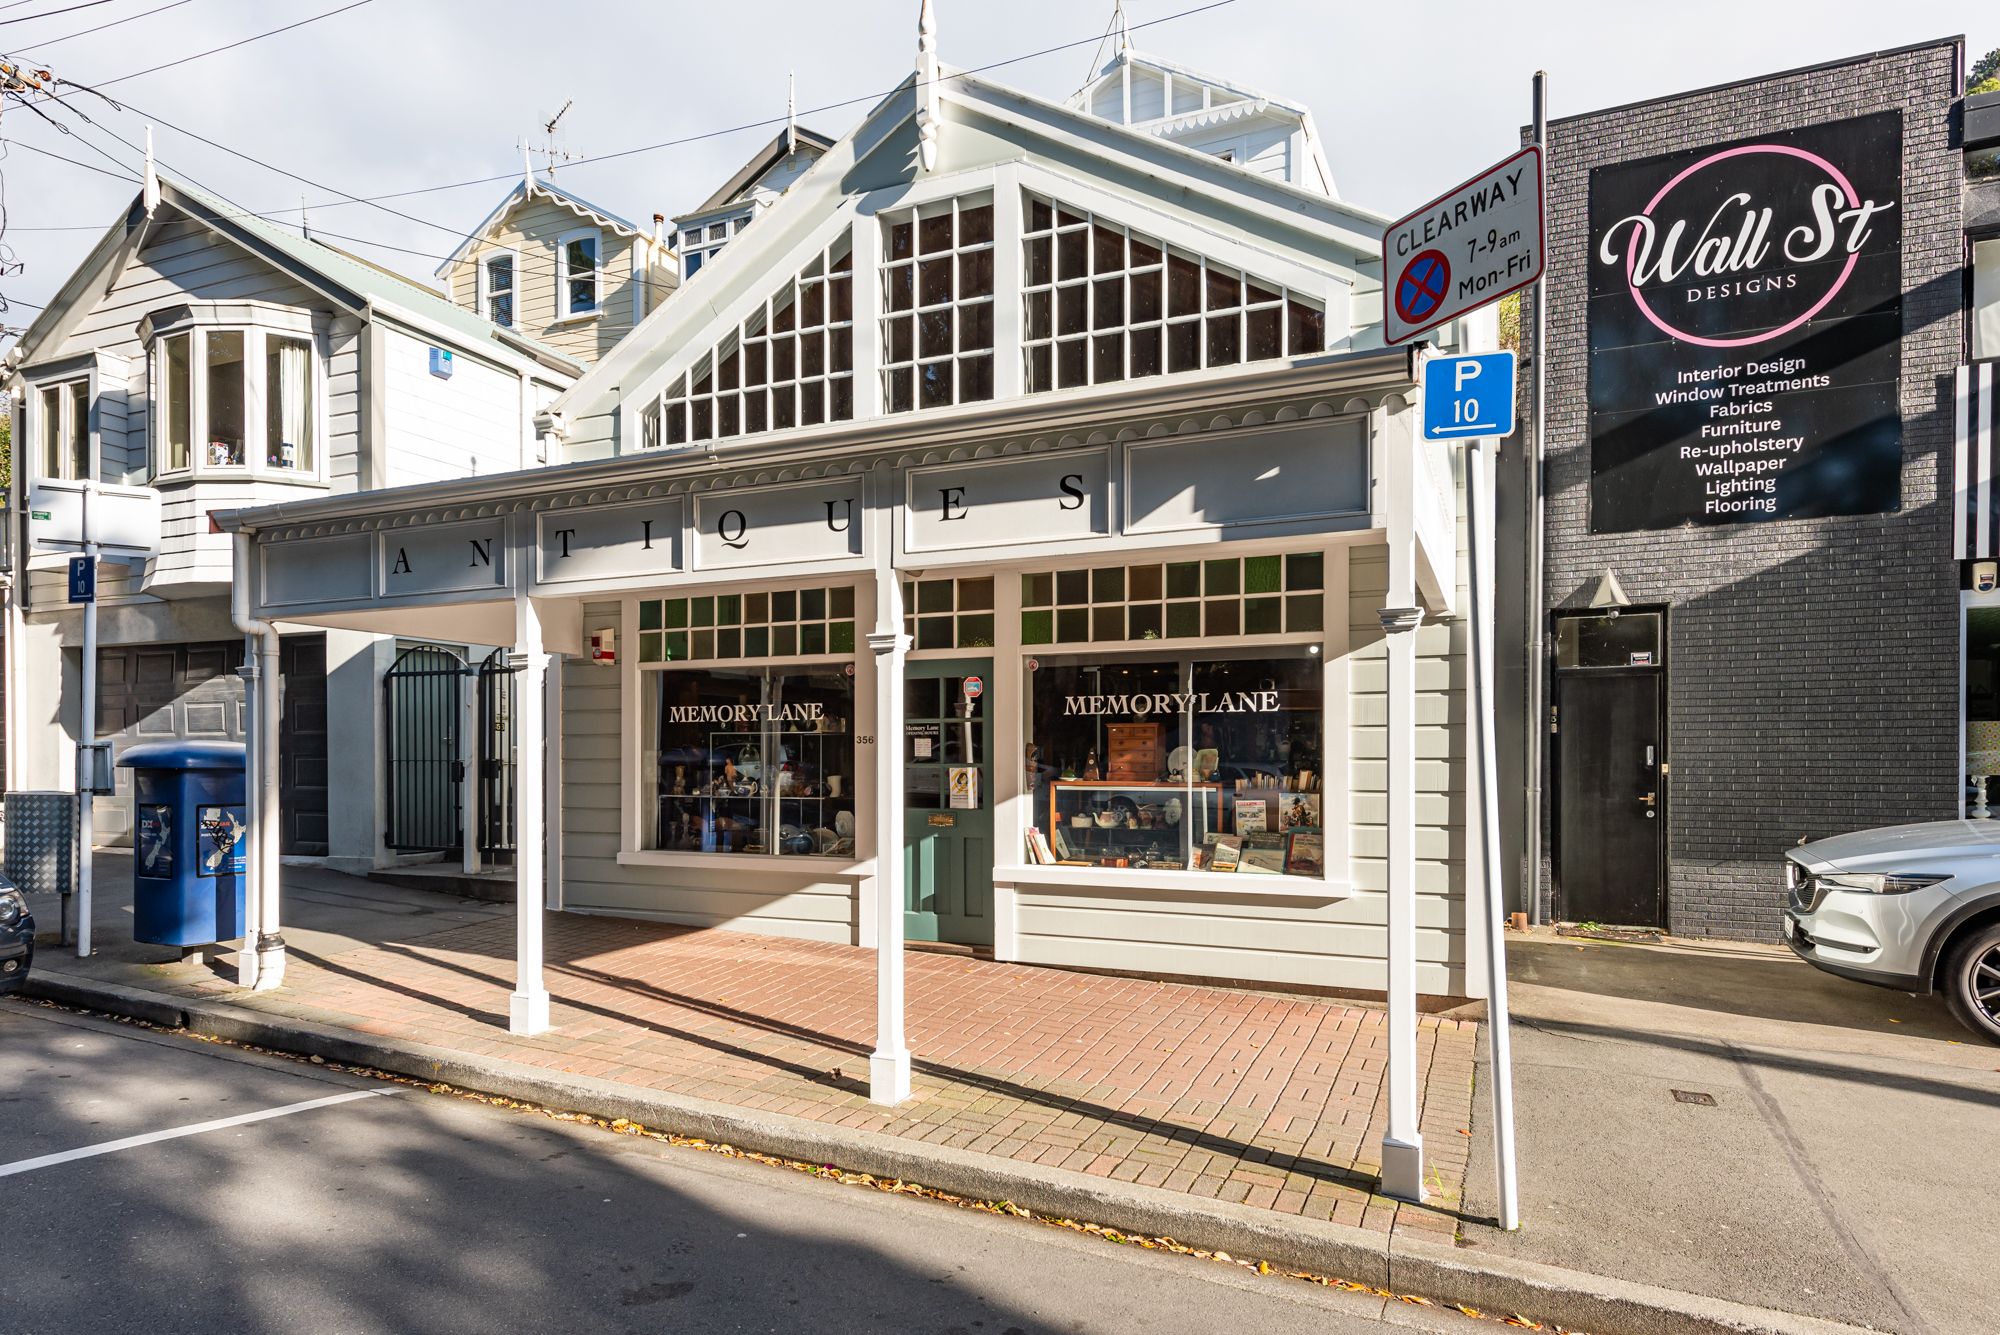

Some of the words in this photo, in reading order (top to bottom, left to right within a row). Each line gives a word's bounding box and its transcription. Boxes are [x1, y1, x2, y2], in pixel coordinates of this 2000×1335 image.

[1396, 168, 1523, 257] CLEARWAY
[1600, 193, 1772, 287] Wall
[1784, 184, 1895, 262] St
[1459, 249, 1531, 299] Mon-Fri
[1687, 274, 1797, 302] DESIGNS
[1455, 360, 1482, 392] P
[1678, 365, 1742, 384] Interior
[1746, 357, 1806, 374] Design
[1655, 387, 1724, 405] Window
[1728, 374, 1830, 397] Treatments
[1454, 398, 1479, 423] 10
[1710, 400, 1773, 418] Fabrics
[1701, 419, 1781, 438] Furniture
[1680, 436, 1804, 459] Re-upholstery
[1696, 457, 1787, 477] Wallpaper
[1706, 477, 1776, 496] Lighting
[1705, 496, 1777, 514] Flooring
[77, 560, 85, 576] P
[77, 580, 85, 593] 10
[669, 704, 762, 723] MEMORY
[766, 703, 824, 721] LANE
[1063, 693, 1198, 715] MEMORY
[1198, 691, 1281, 713] LANE
[856, 735, 874, 745] 356
